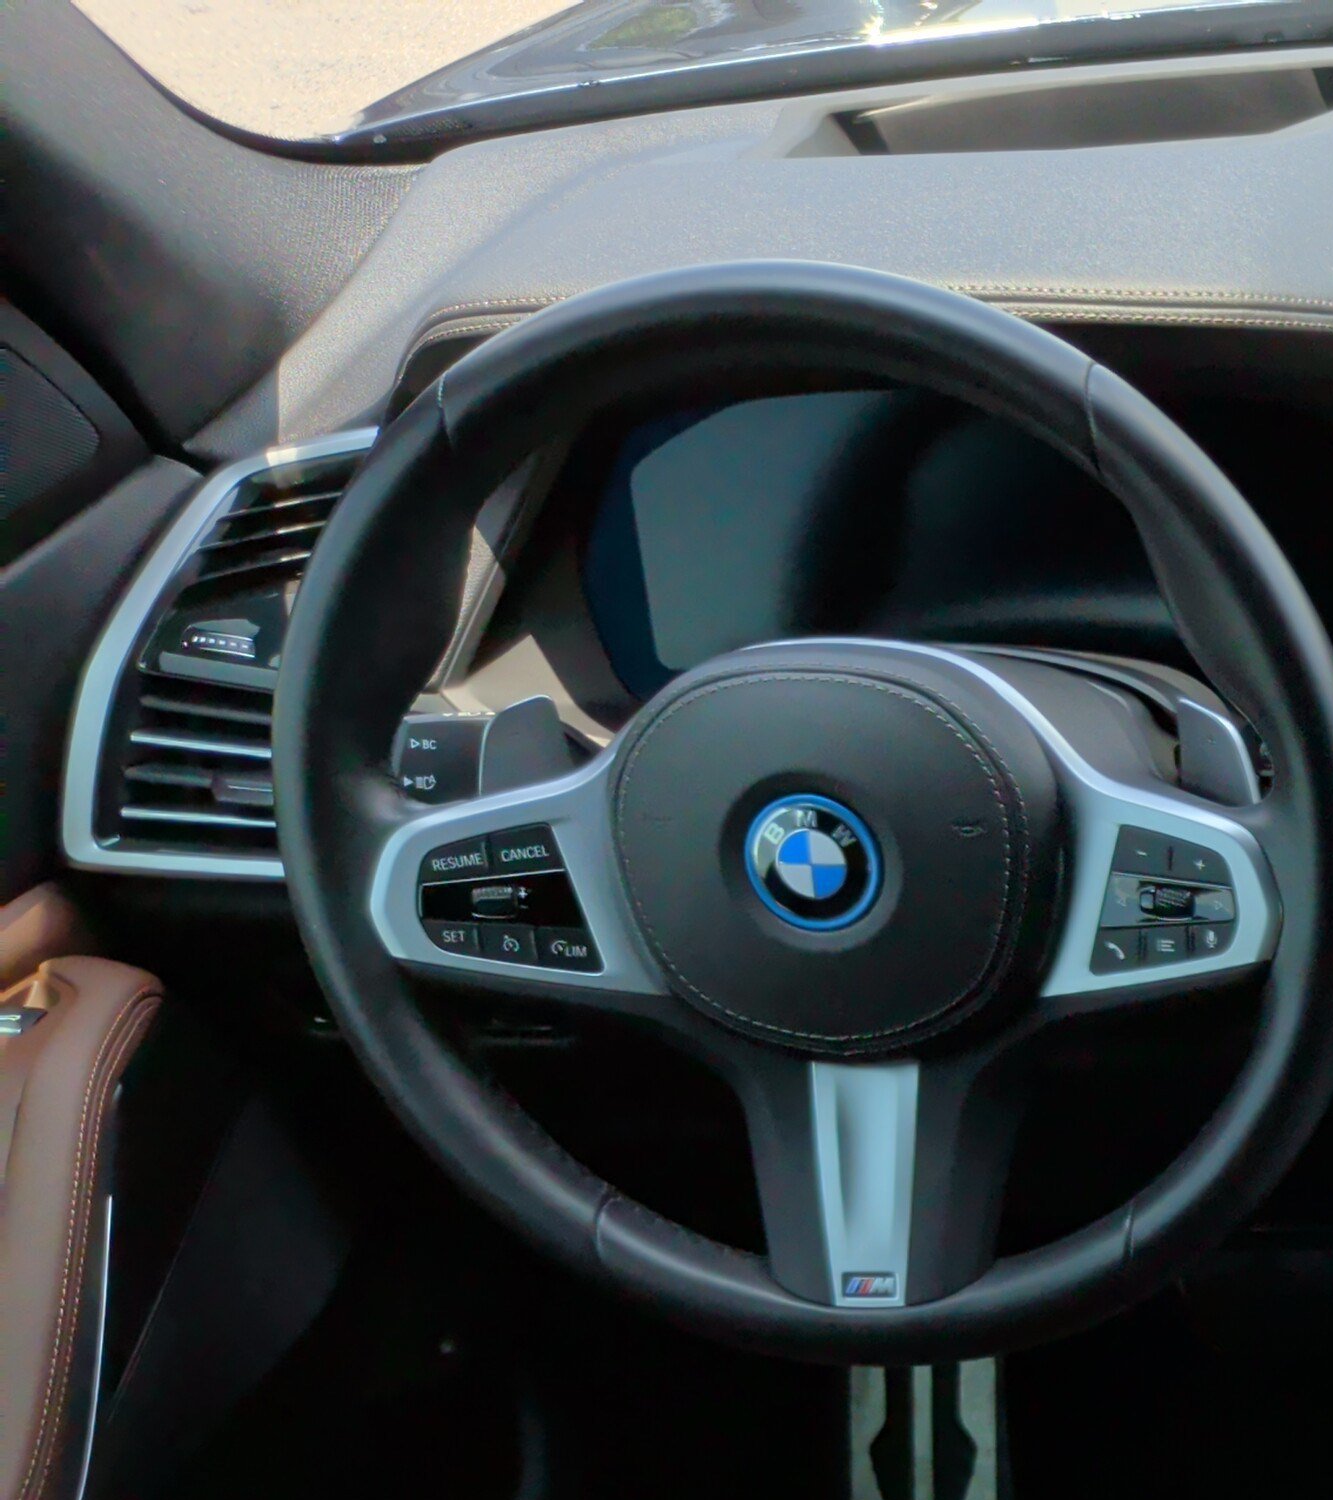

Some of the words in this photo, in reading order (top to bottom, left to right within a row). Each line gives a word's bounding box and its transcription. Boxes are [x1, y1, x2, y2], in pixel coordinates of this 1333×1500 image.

[422, 739, 437, 750] BC
[764, 810, 857, 848] BMW
[501, 845, 549, 862] CANCEL
[432, 852, 484, 871] RESUME
[442, 930, 465, 943] SET
[565, 946, 587, 958] LIM
